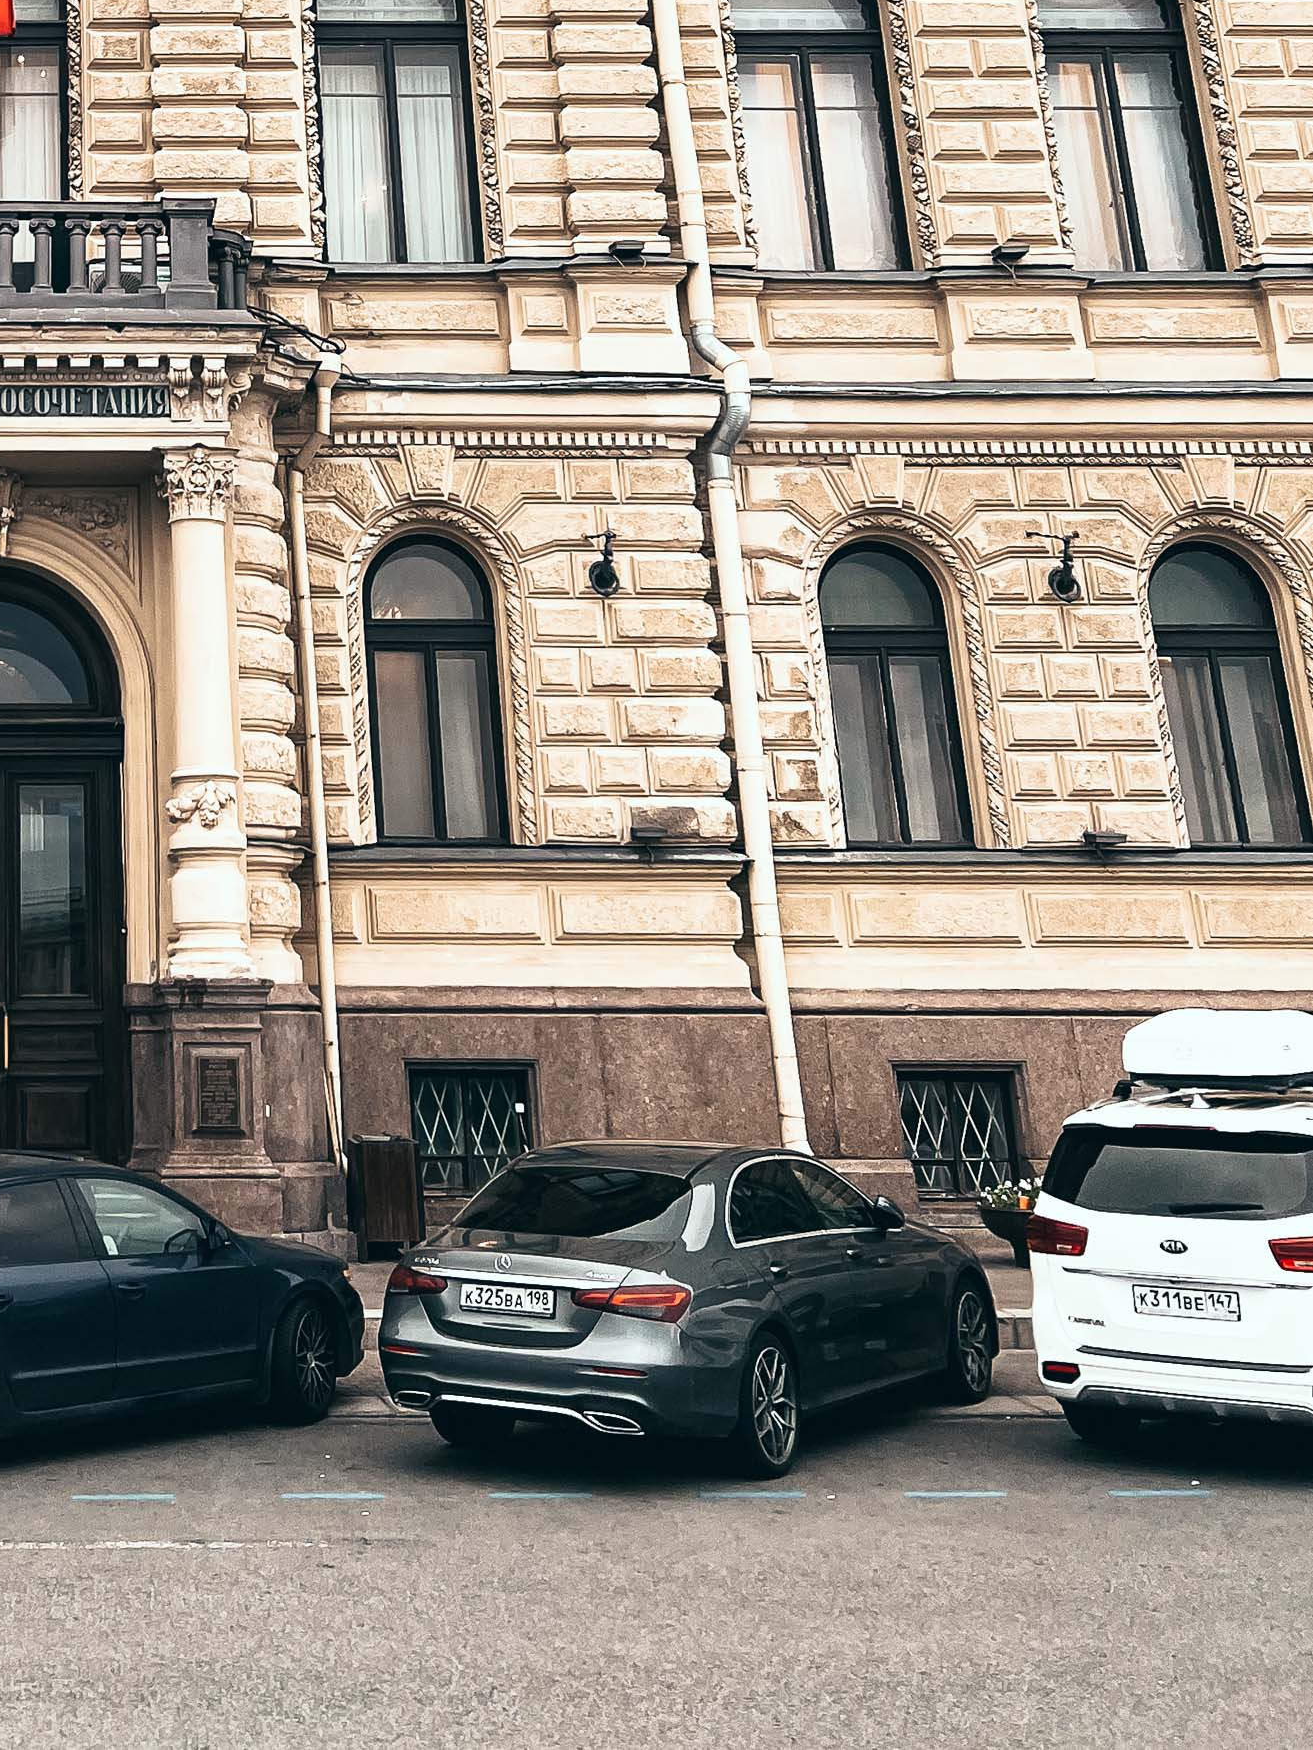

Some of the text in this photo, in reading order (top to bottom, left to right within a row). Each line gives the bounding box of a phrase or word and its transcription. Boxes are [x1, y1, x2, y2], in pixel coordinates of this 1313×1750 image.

[1162, 1240, 1185, 1252] KIA
[526, 1290, 549, 1306] 198
[1208, 1293, 1232, 1309] 147
